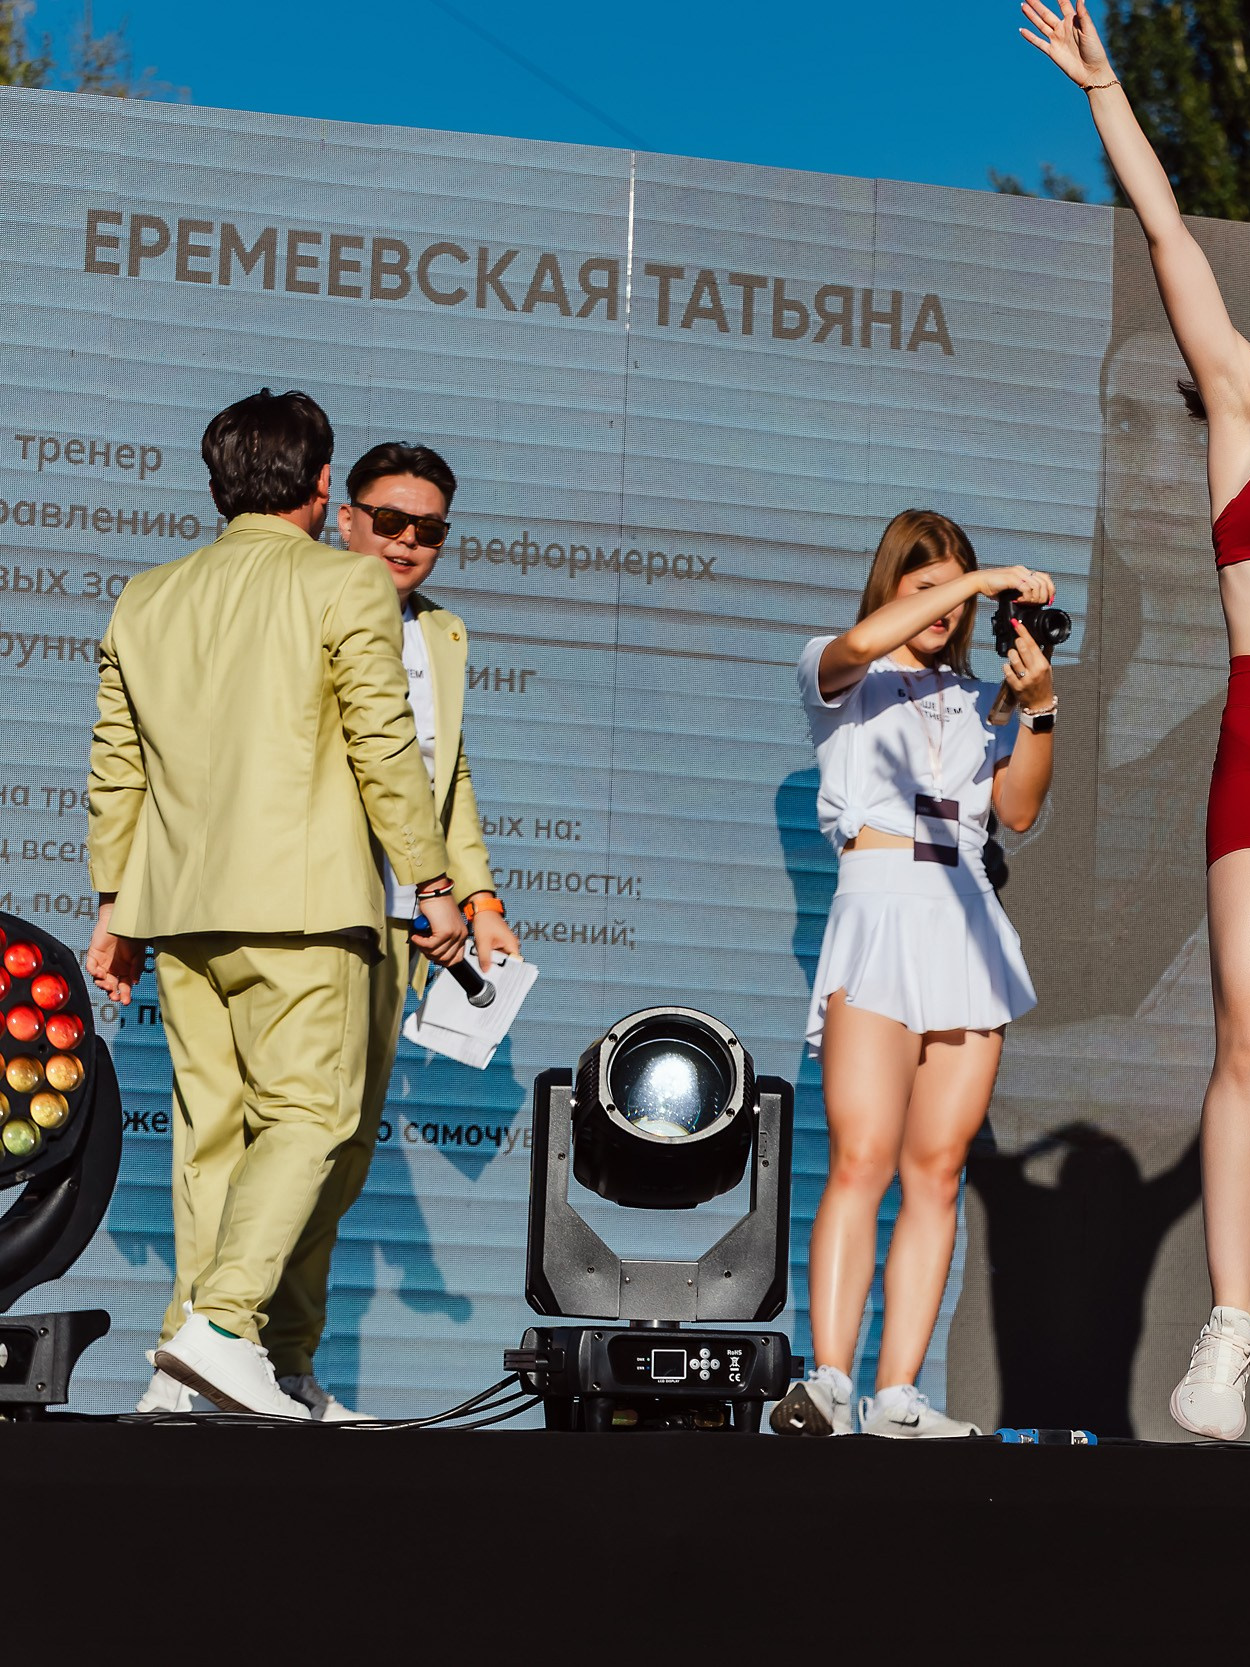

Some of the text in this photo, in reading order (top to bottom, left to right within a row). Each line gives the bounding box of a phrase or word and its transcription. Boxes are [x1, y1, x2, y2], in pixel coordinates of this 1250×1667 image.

[84, 208, 955, 356] ЕРЕМЕЕВСКАЯ ТАТЬЯНА
[14, 434, 163, 480] тренер
[460, 530, 718, 584] реформерах
[535, 817, 582, 841] на:
[33, 892, 95, 920] под
